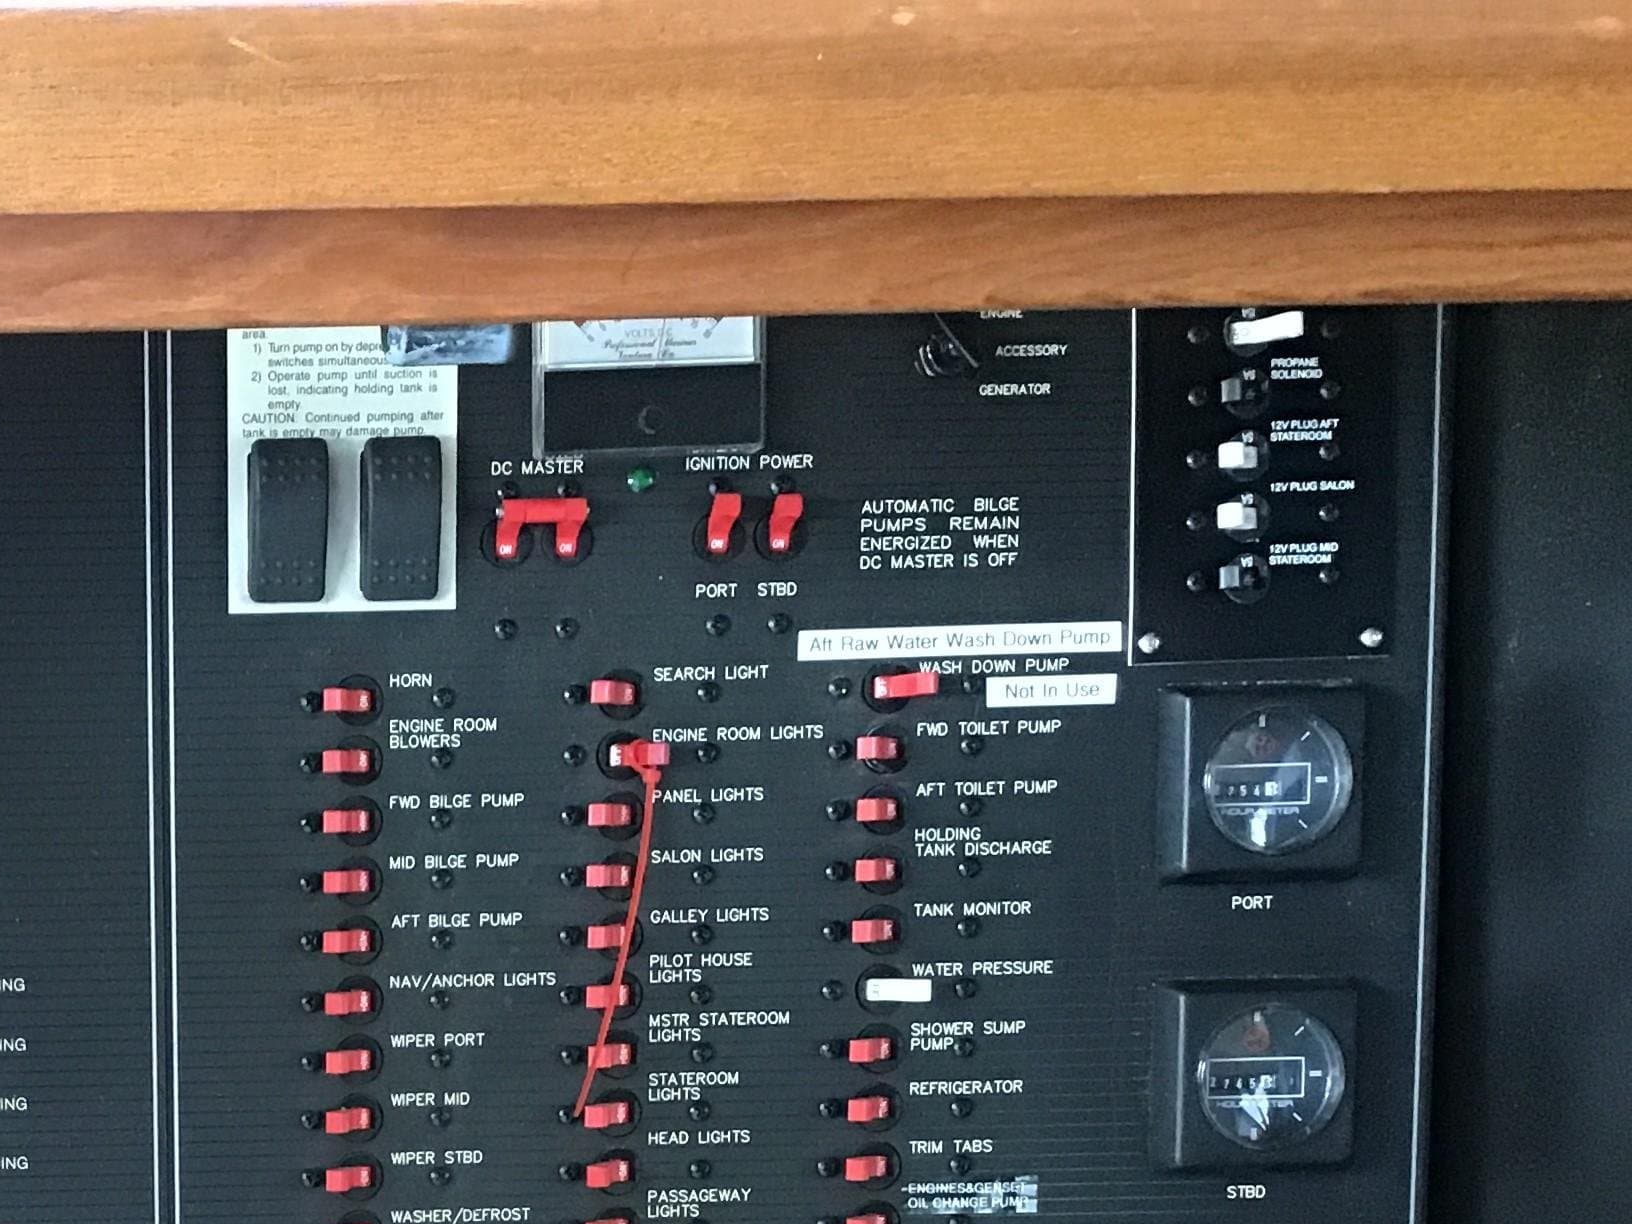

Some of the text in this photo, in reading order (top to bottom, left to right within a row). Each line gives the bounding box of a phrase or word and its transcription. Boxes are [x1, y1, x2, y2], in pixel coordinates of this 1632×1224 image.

[1271, 357, 1318, 367] PROPANE
[268, 370, 310, 383] Operate
[318, 372, 347, 383] pump
[355, 369, 377, 380] until
[384, 370, 422, 379] suction
[430, 370, 437, 378] is
[1271, 369, 1322, 379] SOLENOID
[492, 459, 583, 475] DC MASTER
[686, 454, 813, 470] IGNITION POWER
[1271, 480, 1354, 492] 12V PLUG SALON
[862, 497, 1019, 514] AUTOMATIC BILGE
[861, 516, 1019, 532] PUMPS REMAIN
[861, 534, 1018, 551] ENERGIZED WHEN
[860, 552, 1018, 569] DC MASTER IS OFF
[696, 583, 737, 598] PORT
[758, 582, 797, 596] STBD
[810, 630, 1110, 651] Aft Raw Water Wash Down Pump
[390, 673, 432, 687] HORN
[654, 665, 768, 681] SEARCH LIGHT
[1006, 683, 1099, 698] Not In Use
[390, 718, 496, 733] ENGINE ROOM
[390, 734, 460, 749] BLOWERS
[914, 901, 1031, 916] TANK MONITOR
[1232, 896, 1273, 909] PORT
[912, 960, 1053, 976] WATER PRESSURE
[390, 972, 556, 991] NAV/ANCHOR LIGHTS
[910, 1080, 1023, 1095] REFRIGERATOR
[909, 1139, 992, 1153] TRIM TABS
[391, 1208, 530, 1224] WASHER/DEFROST
